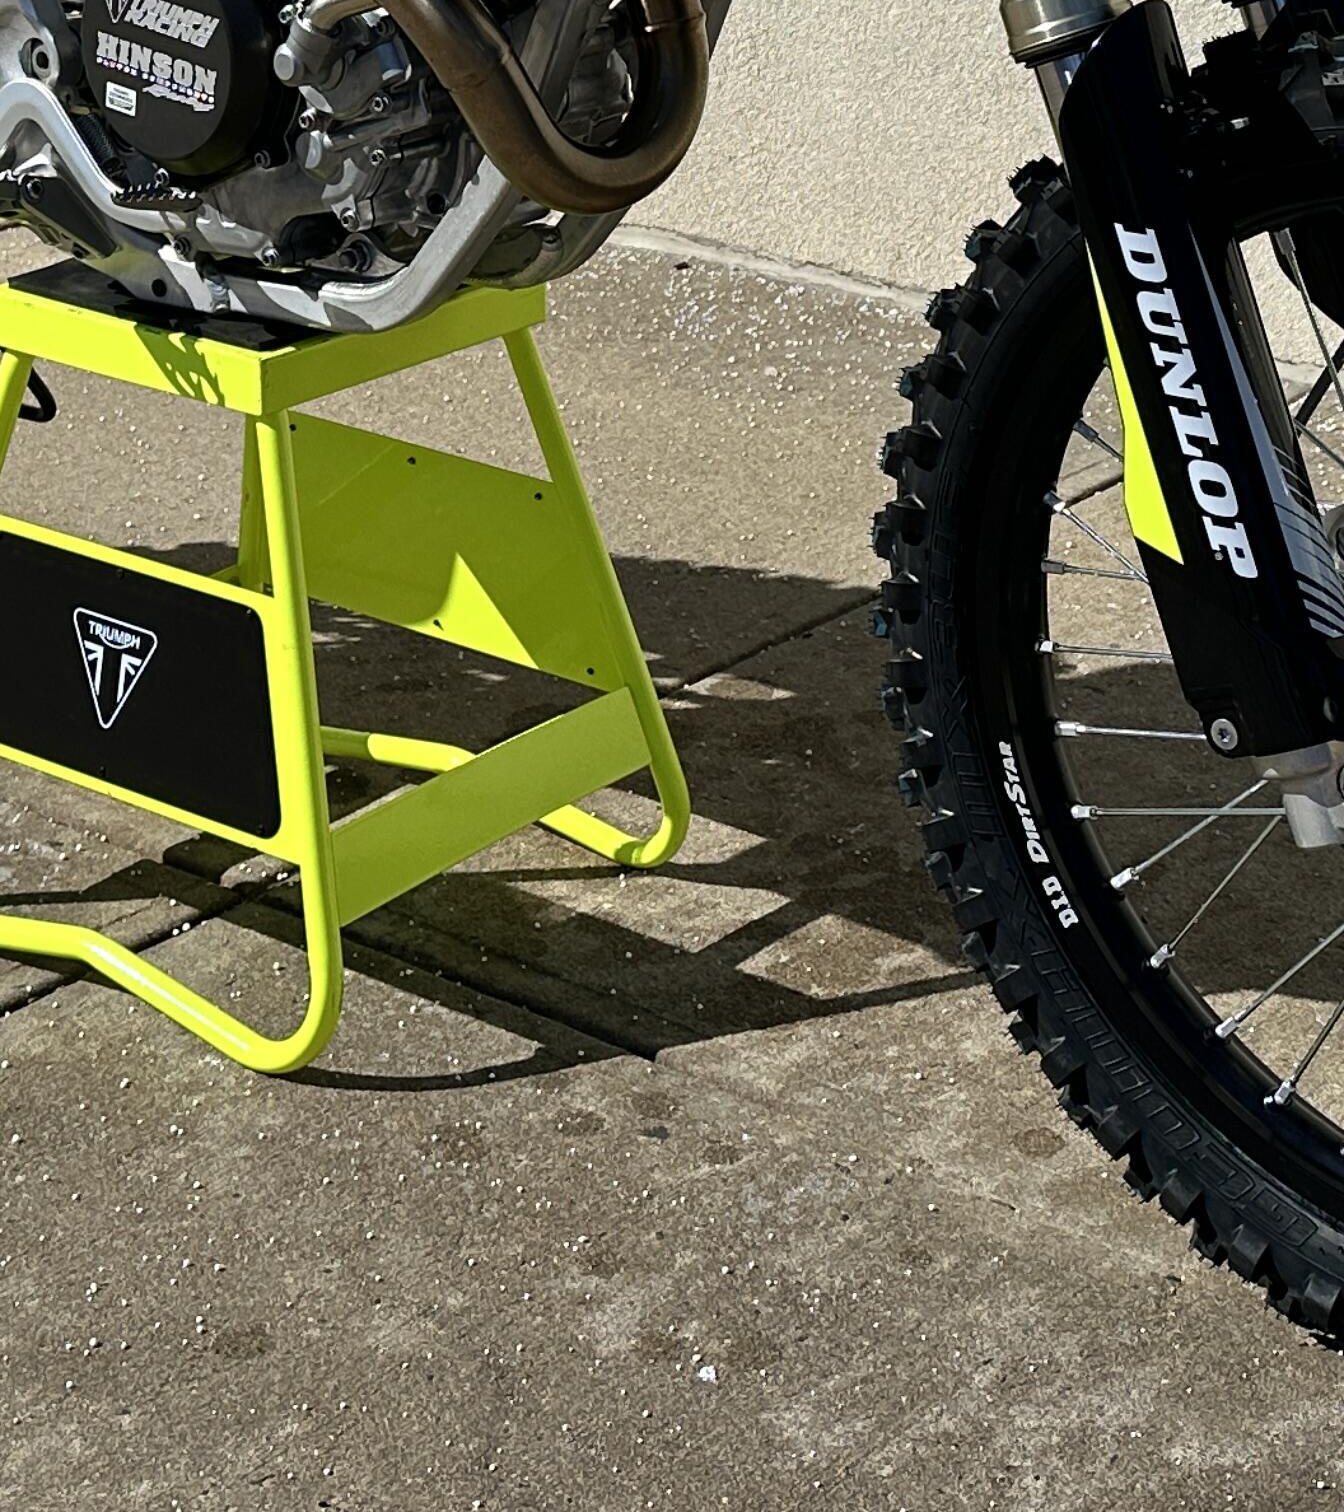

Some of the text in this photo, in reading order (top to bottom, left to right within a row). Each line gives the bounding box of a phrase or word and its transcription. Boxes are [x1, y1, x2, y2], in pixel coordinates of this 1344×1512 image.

[123, 7, 214, 49] RACING
[96, 30, 218, 96] HINSON
[1113, 221, 1258, 580] DUNLOP
[88, 619, 141, 650] TRIUMPH
